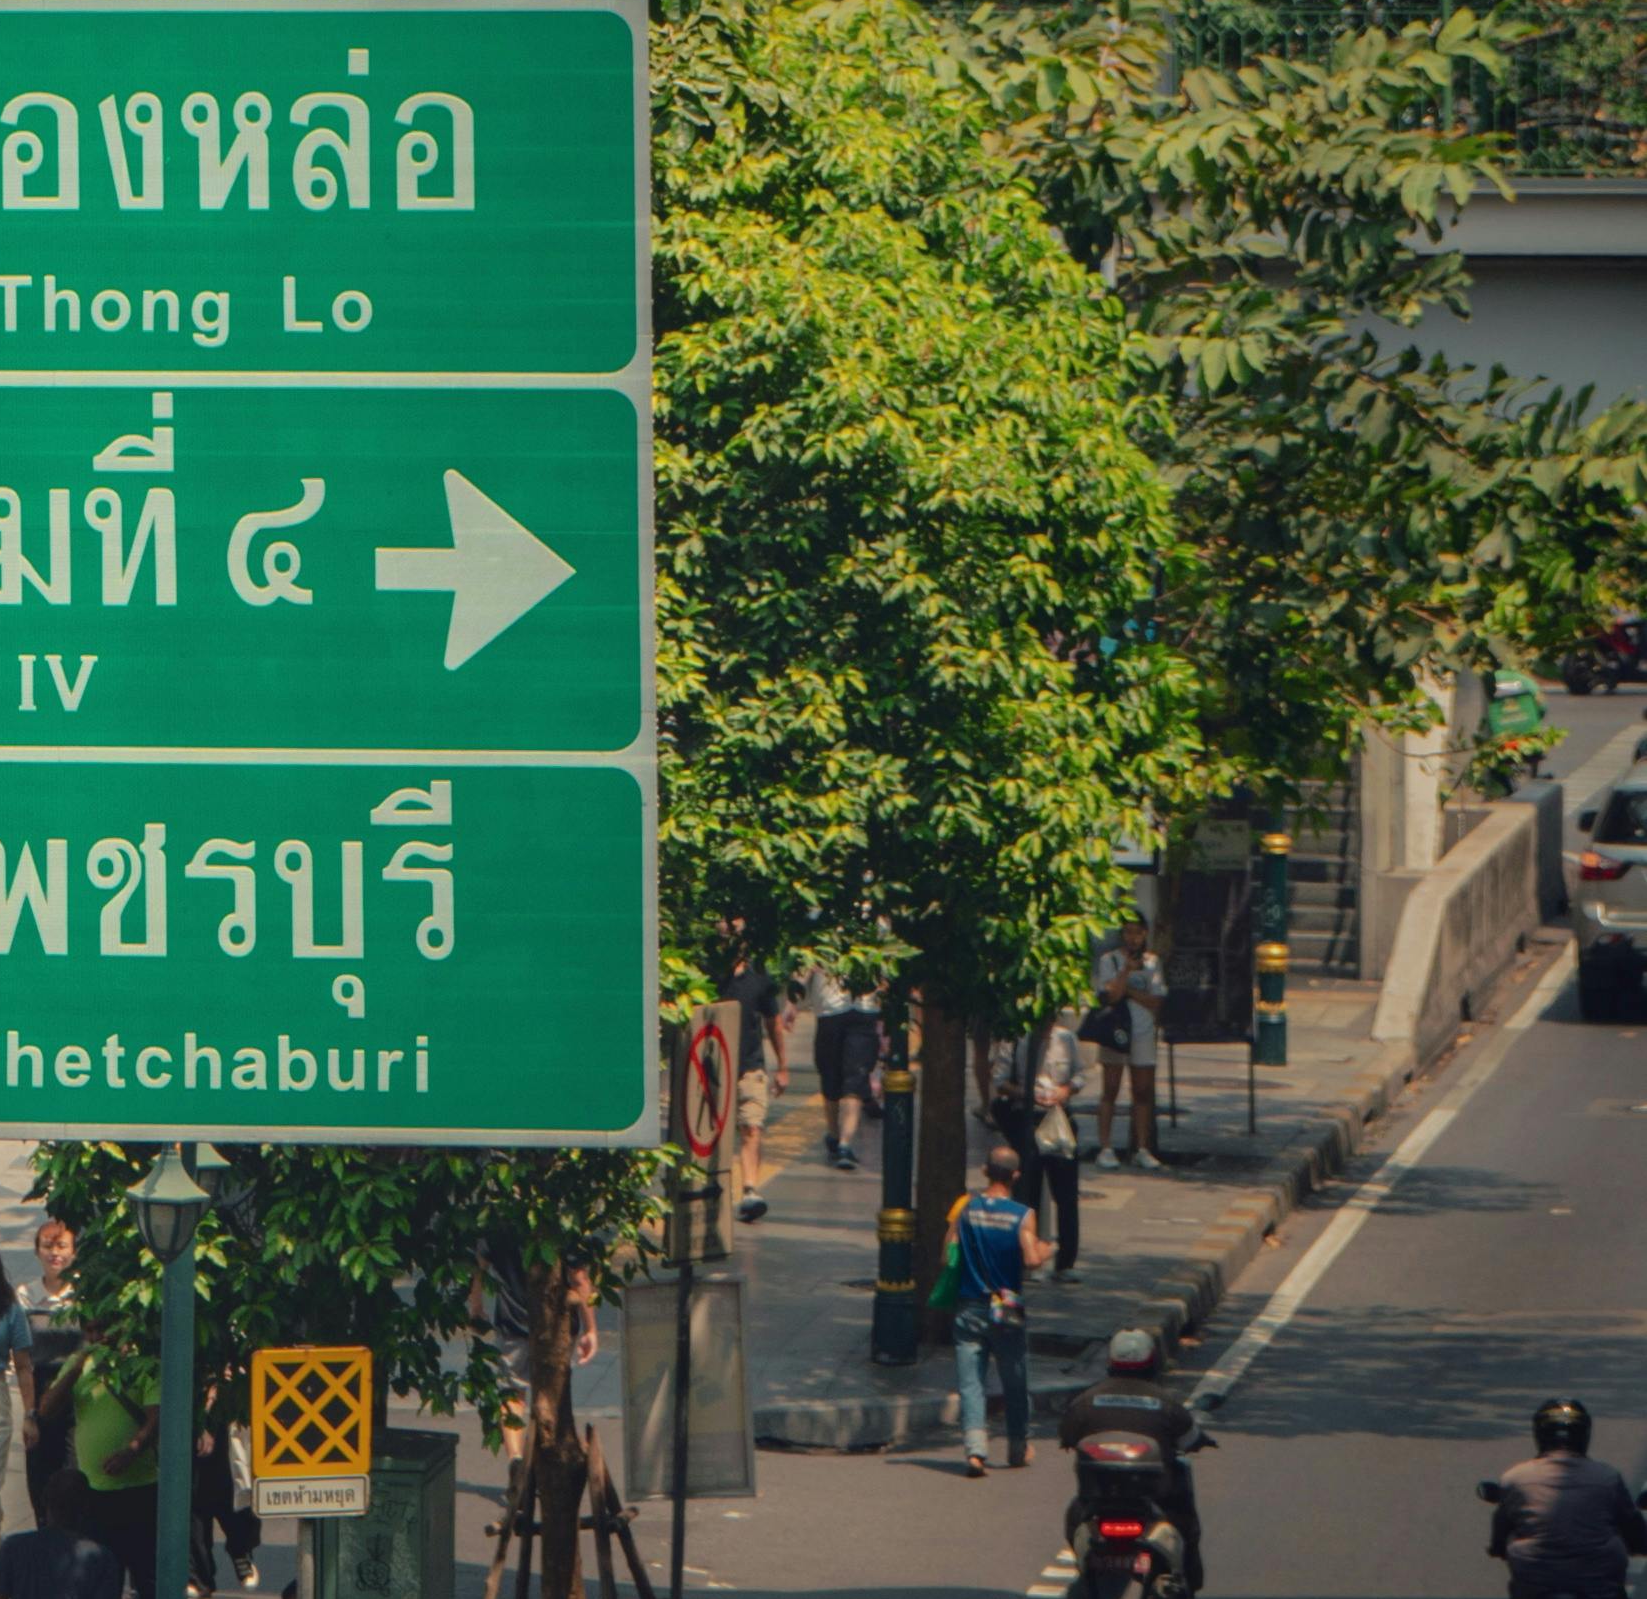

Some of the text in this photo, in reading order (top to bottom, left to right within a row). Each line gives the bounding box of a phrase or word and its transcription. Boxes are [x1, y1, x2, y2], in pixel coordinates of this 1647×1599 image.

[284, 276, 373, 331] Lo
[228, 478, 325, 606] ๔
[19, 655, 98, 711] IV
[265, 1484, 356, 1508] เขตห้ามหยุด
